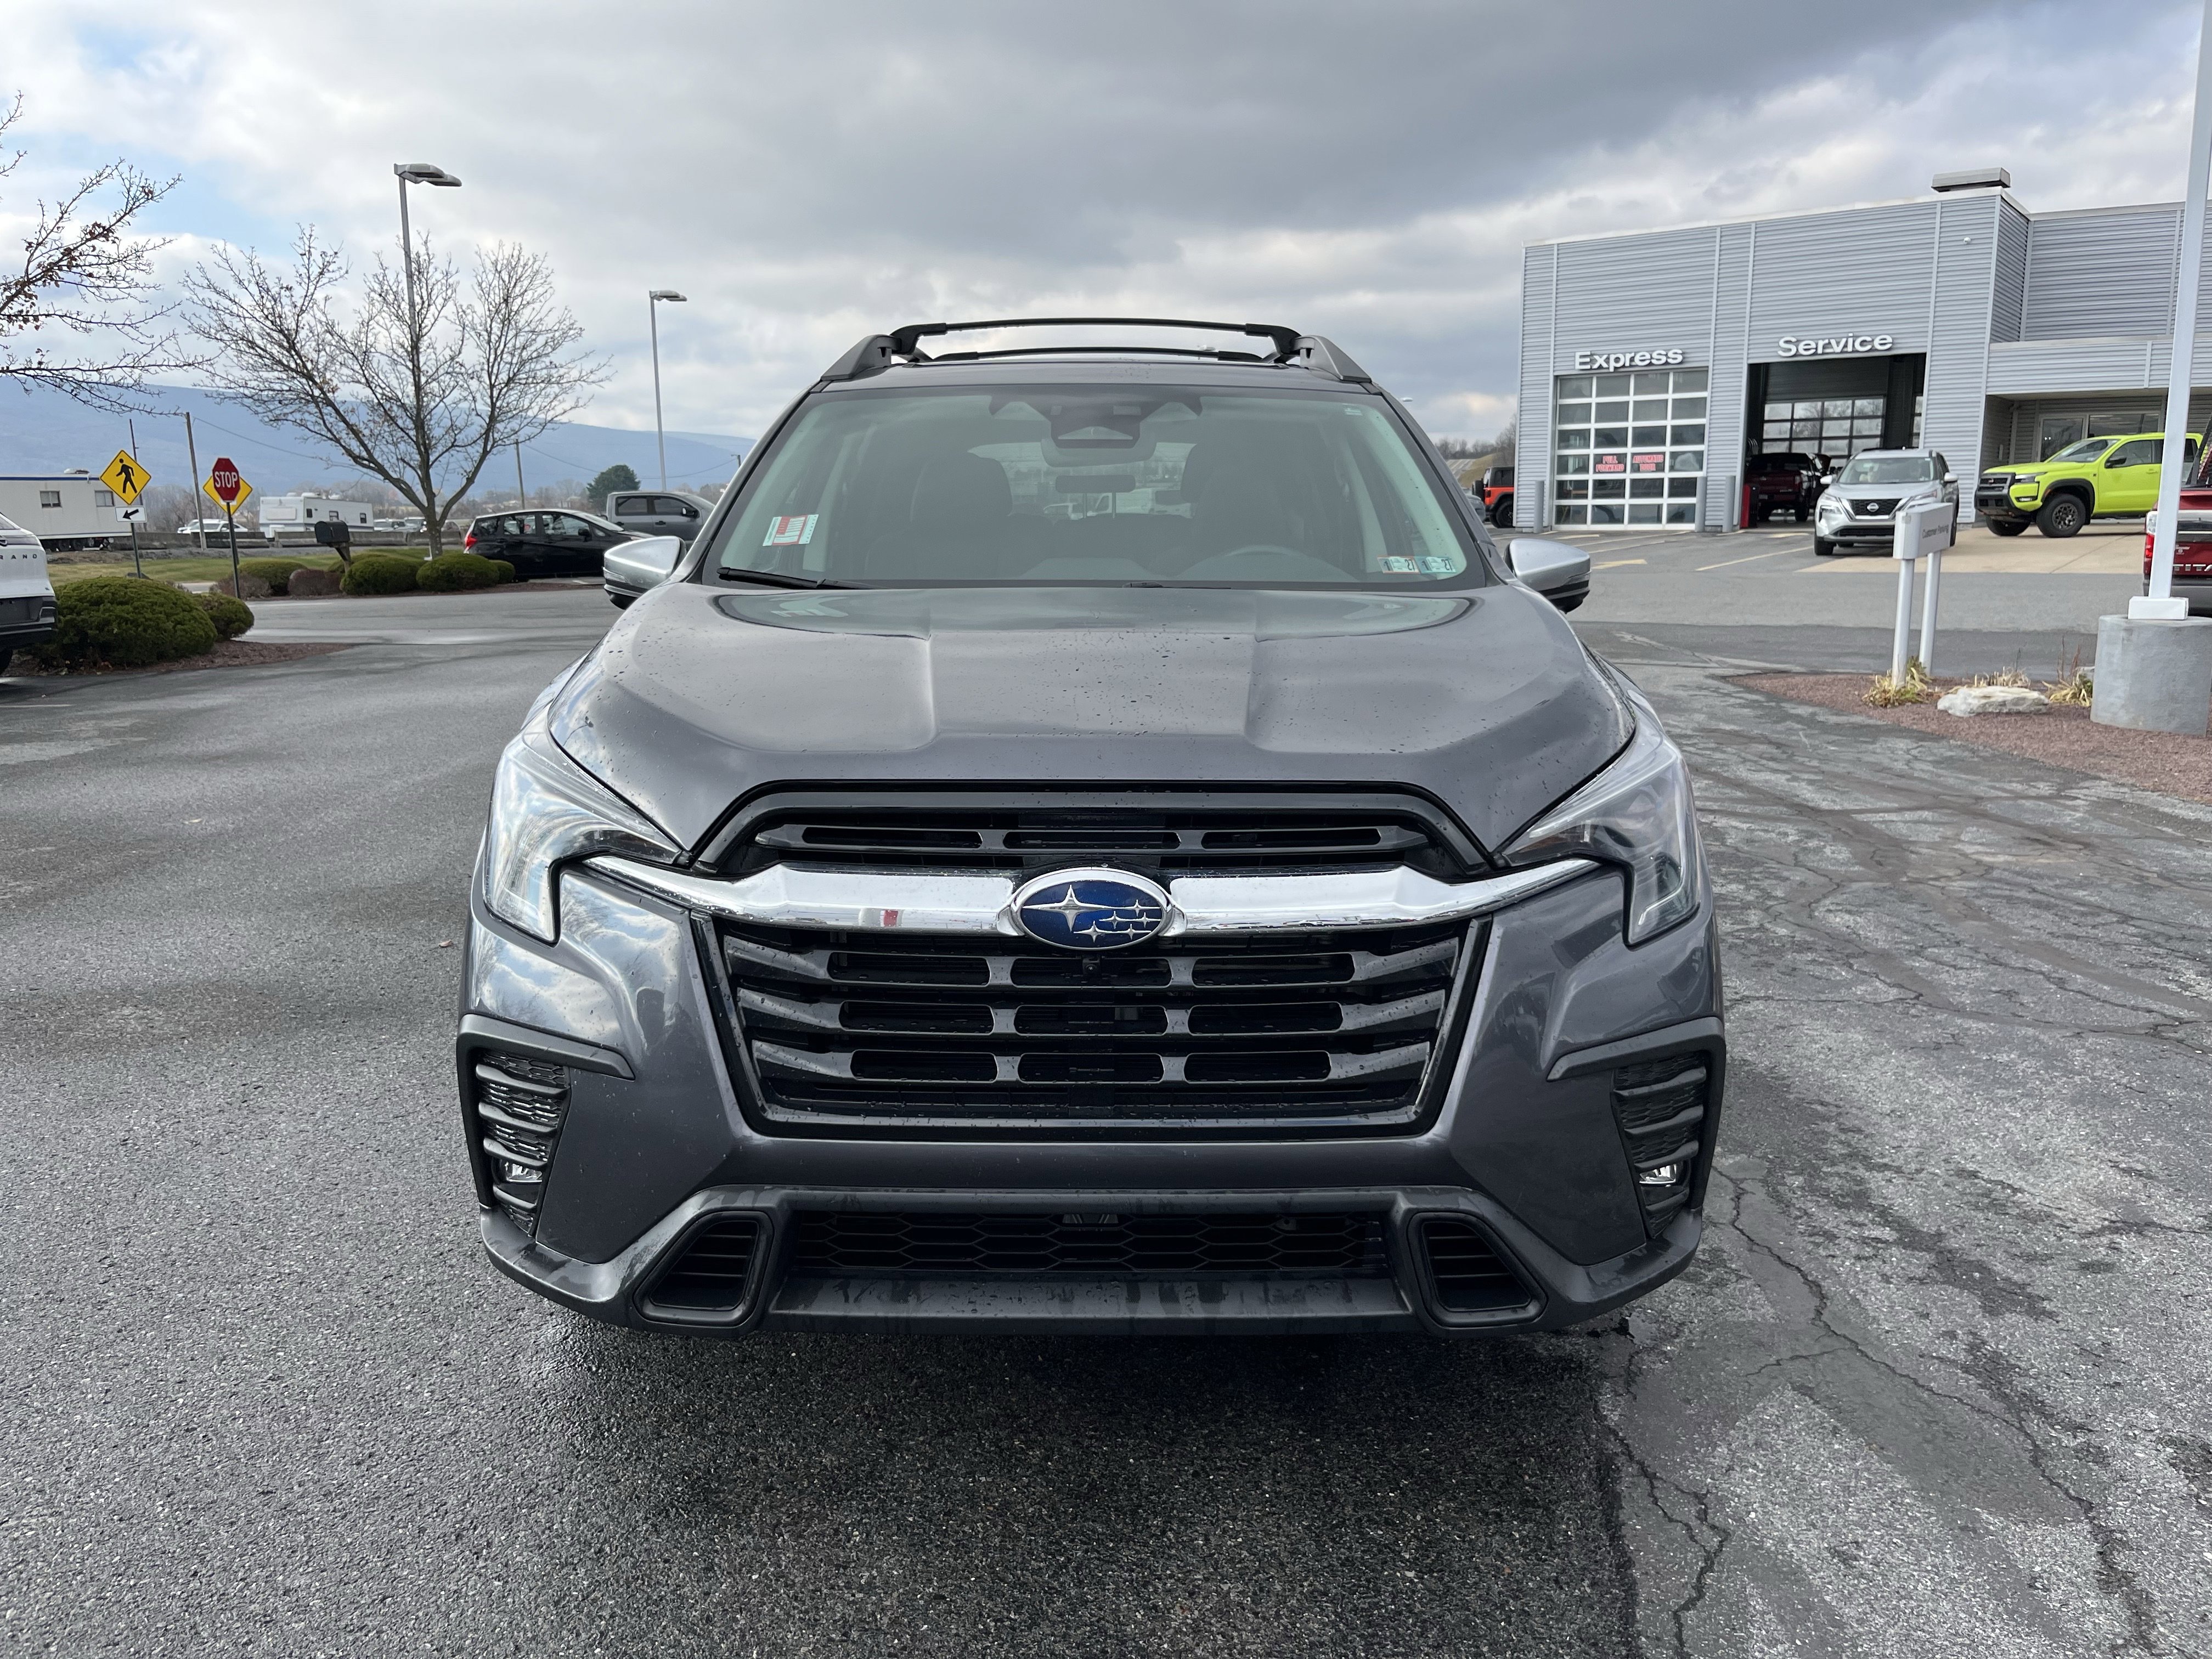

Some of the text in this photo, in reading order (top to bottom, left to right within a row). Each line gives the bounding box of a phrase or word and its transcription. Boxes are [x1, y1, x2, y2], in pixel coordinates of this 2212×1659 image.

[1777, 333, 1893, 357] Service
[1574, 348, 1683, 372] Express
[1633, 455, 1664, 463] AUTOMATIC
[1596, 464, 1624, 472] FORWARD
[215, 471, 238, 488] STOP
